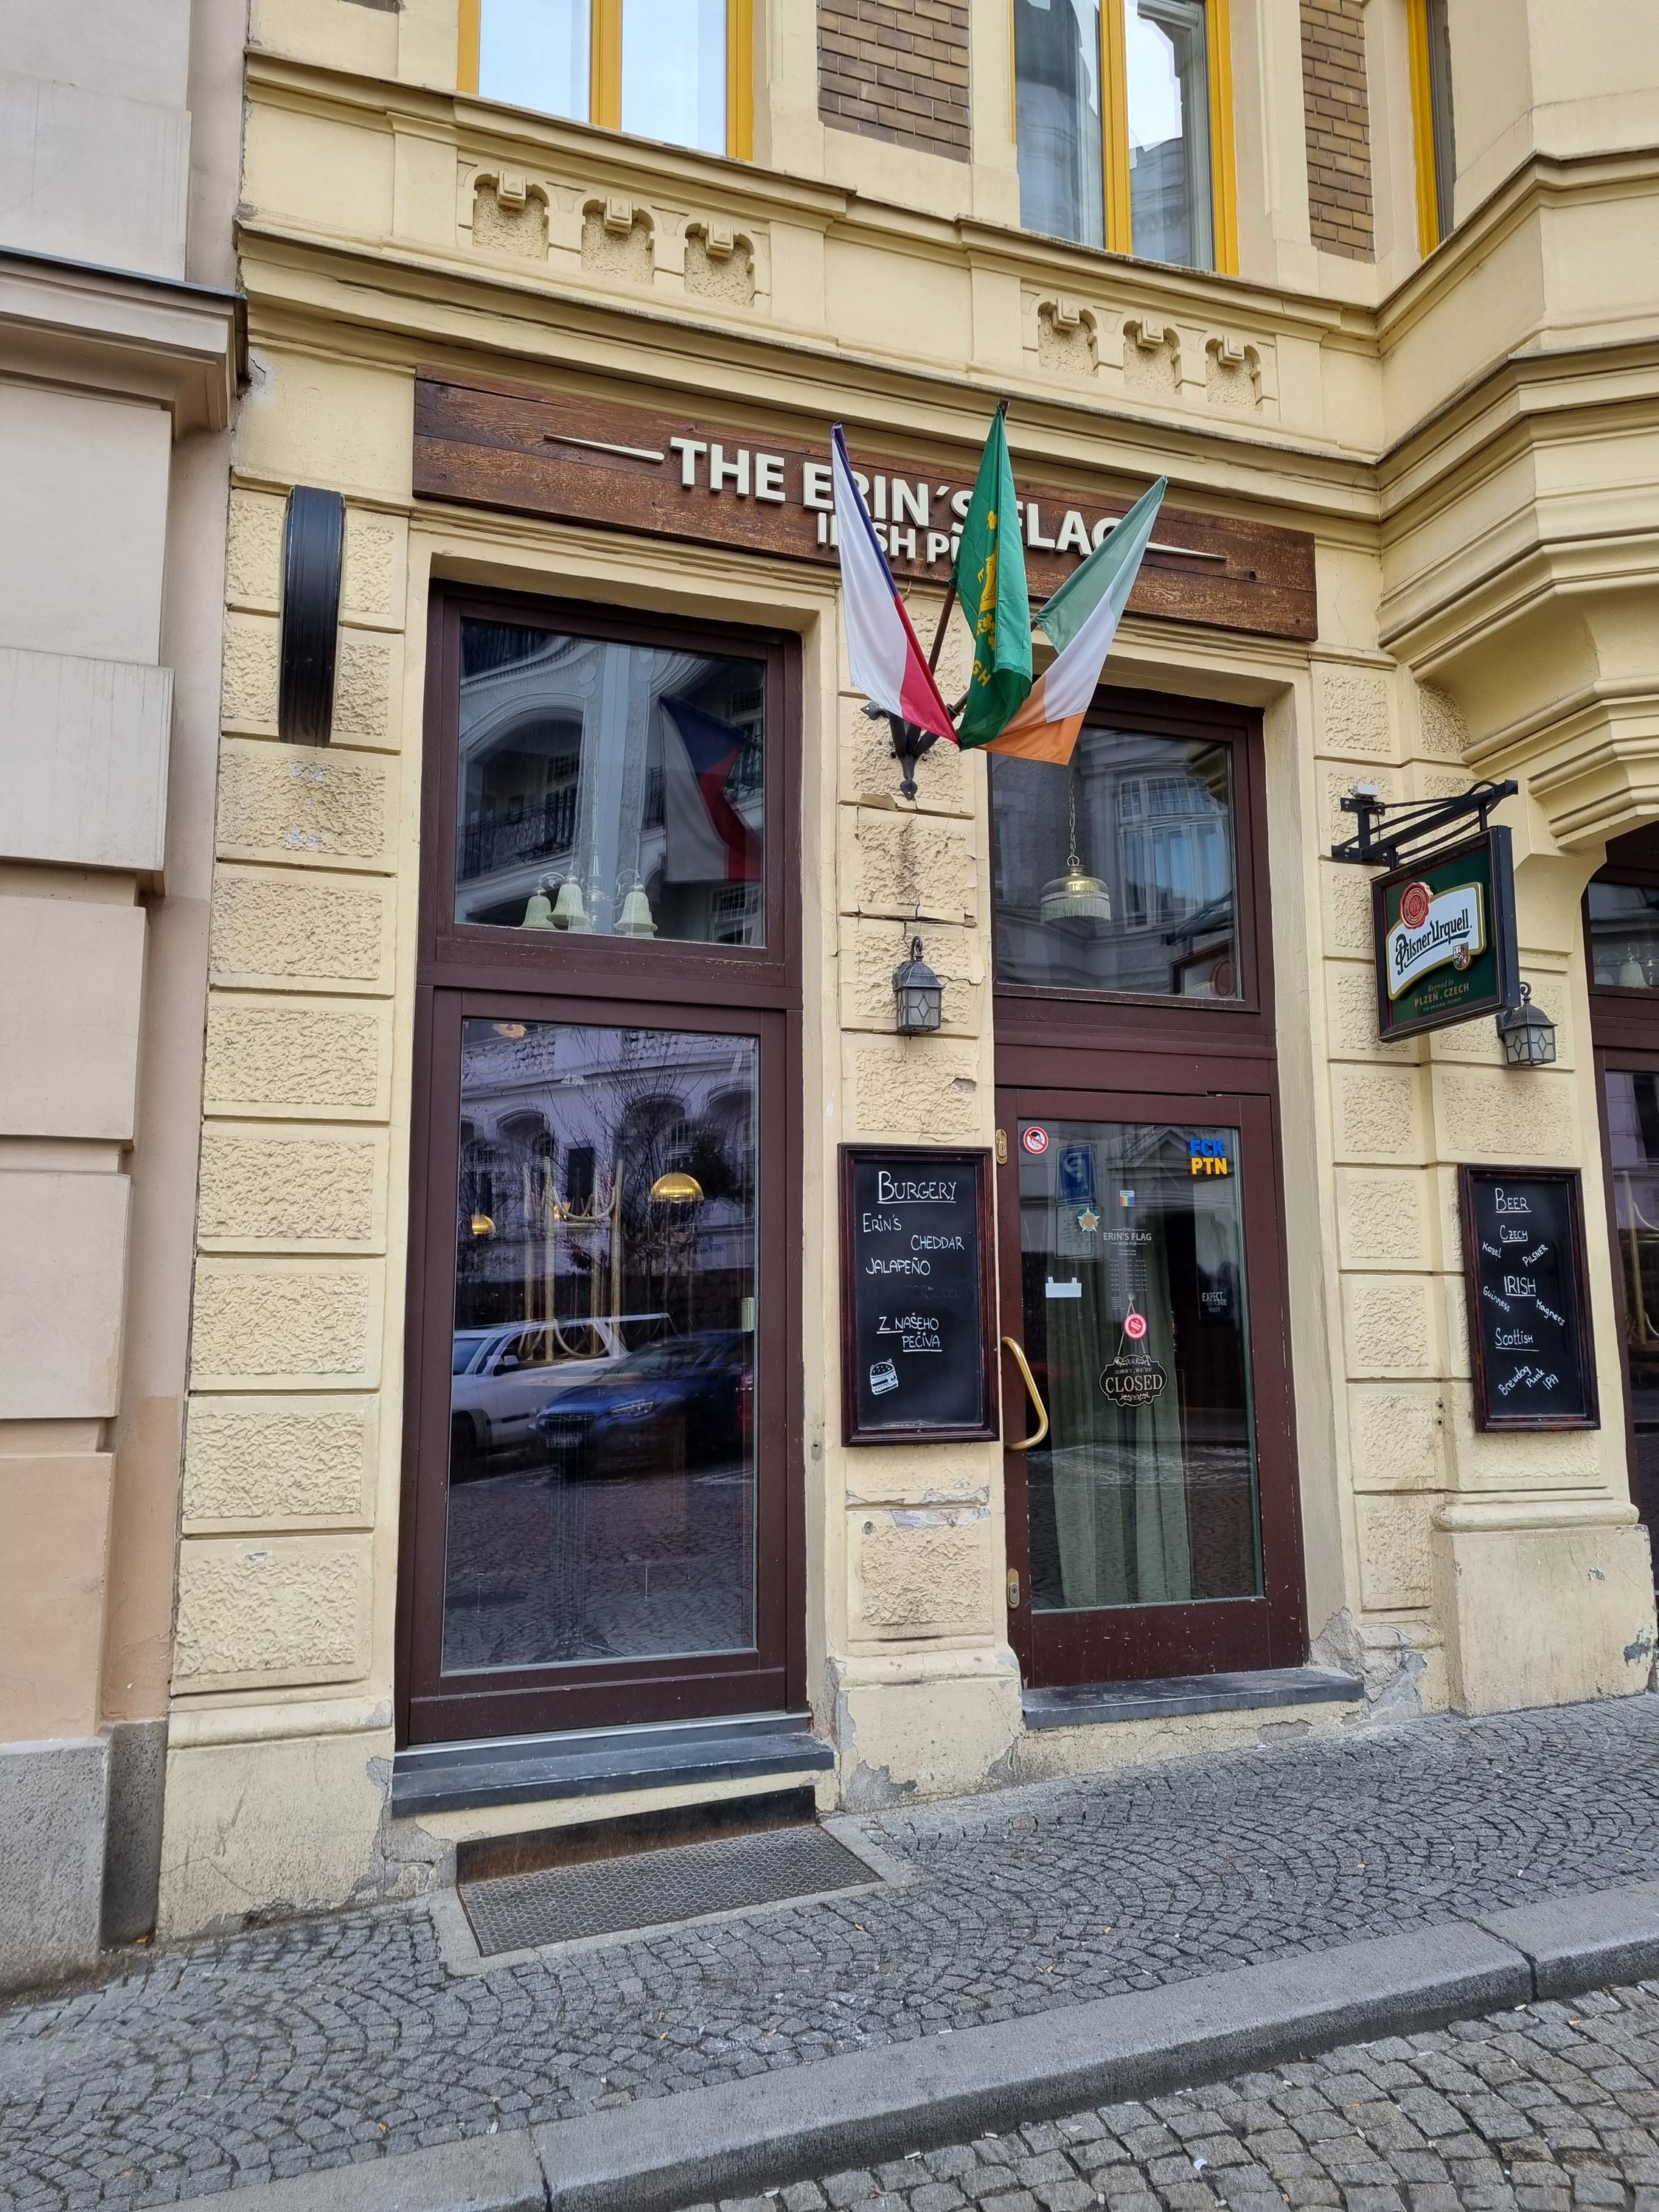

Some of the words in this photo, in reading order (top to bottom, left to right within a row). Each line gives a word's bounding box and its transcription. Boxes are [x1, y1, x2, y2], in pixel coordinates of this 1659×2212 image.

[669, 436, 786, 504] THE
[1016, 501, 1122, 557] LA
[818, 512, 917, 560] ISH
[1395, 931, 1432, 975] Pilsner
[1444, 982, 1470, 998] CZECH
[1190, 1139, 1225, 1157] FCK
[1191, 1158, 1228, 1175] PTN
[911, 1234, 965, 1251] CHEDDAR
[1103, 1232, 1130, 1241] ERIN'S
[1131, 1233, 1152, 1241] FLAG
[1482, 1241, 1502, 1258] Kozel
[1522, 1244, 1549, 1267] PILSNER
[866, 1257, 931, 1276] JALAPEÑO
[1503, 1276, 1537, 1295] IRISH
[1202, 1291, 1223, 1301] EXPECT
[1483, 1286, 1511, 1312] Guinness
[879, 1316, 891, 1331] Z
[895, 1312, 939, 1331] NAŠEHO
[1536, 1298, 1565, 1326] Magners
[1105, 1374, 1163, 1394] CLOSED
[1526, 1368, 1545, 1388] Punk
[1543, 1374, 1559, 1390] IPA
